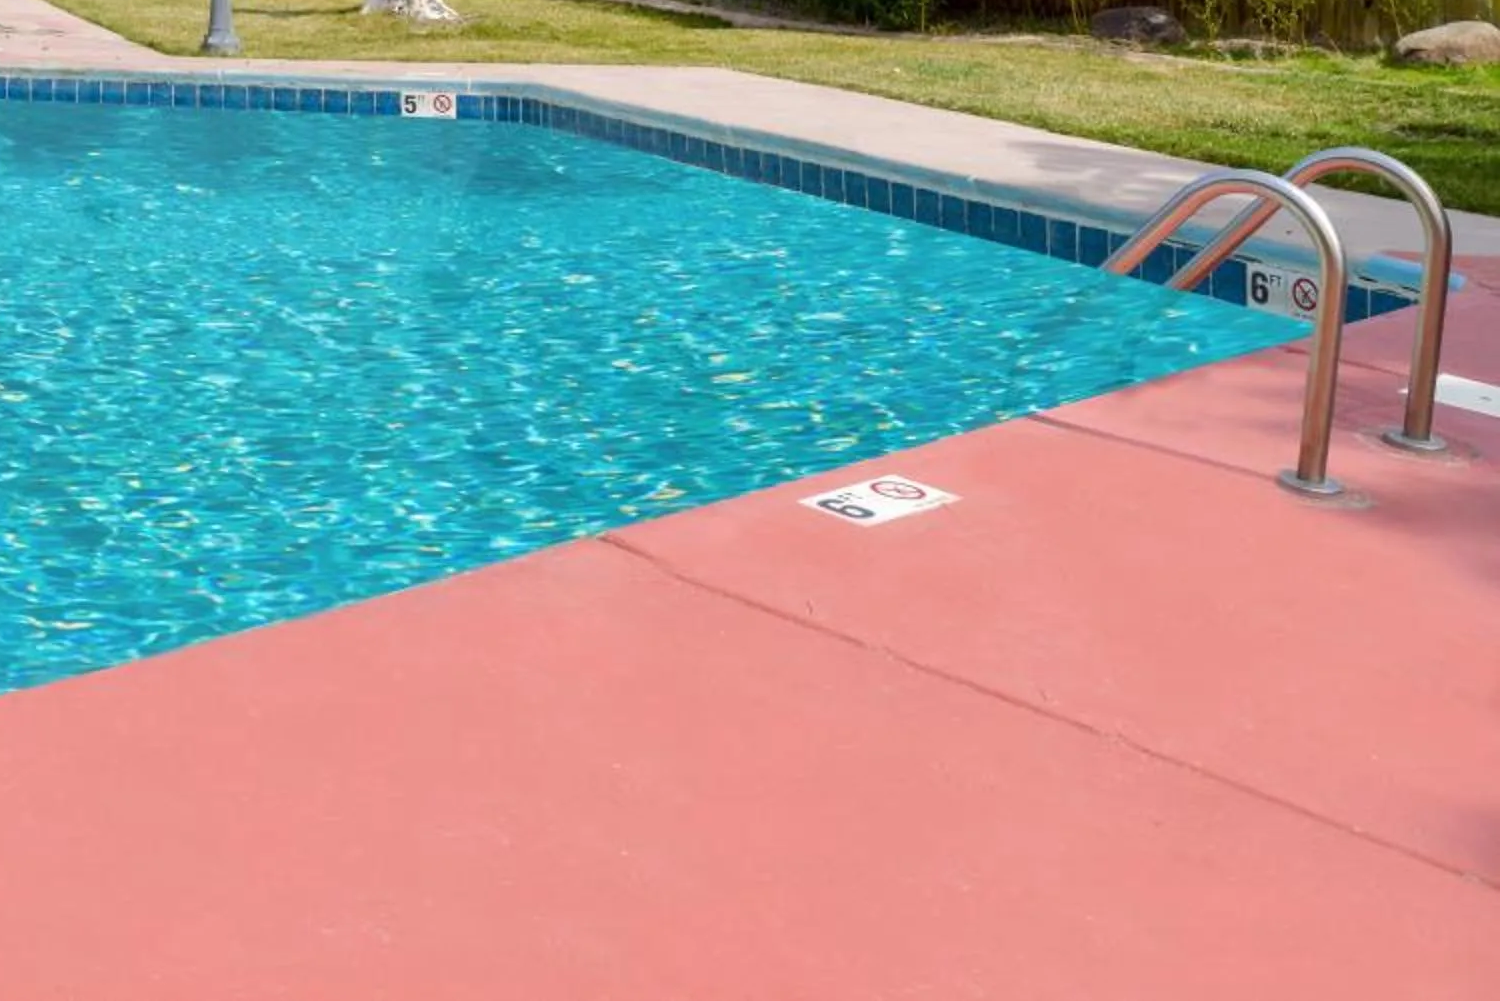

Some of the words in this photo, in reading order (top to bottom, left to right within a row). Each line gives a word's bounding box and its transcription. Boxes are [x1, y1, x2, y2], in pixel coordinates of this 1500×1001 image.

[404, 94, 417, 114] 5
[1251, 271, 1269, 305] 6
[1269, 274, 1282, 287] FT
[816, 499, 876, 518] 6
